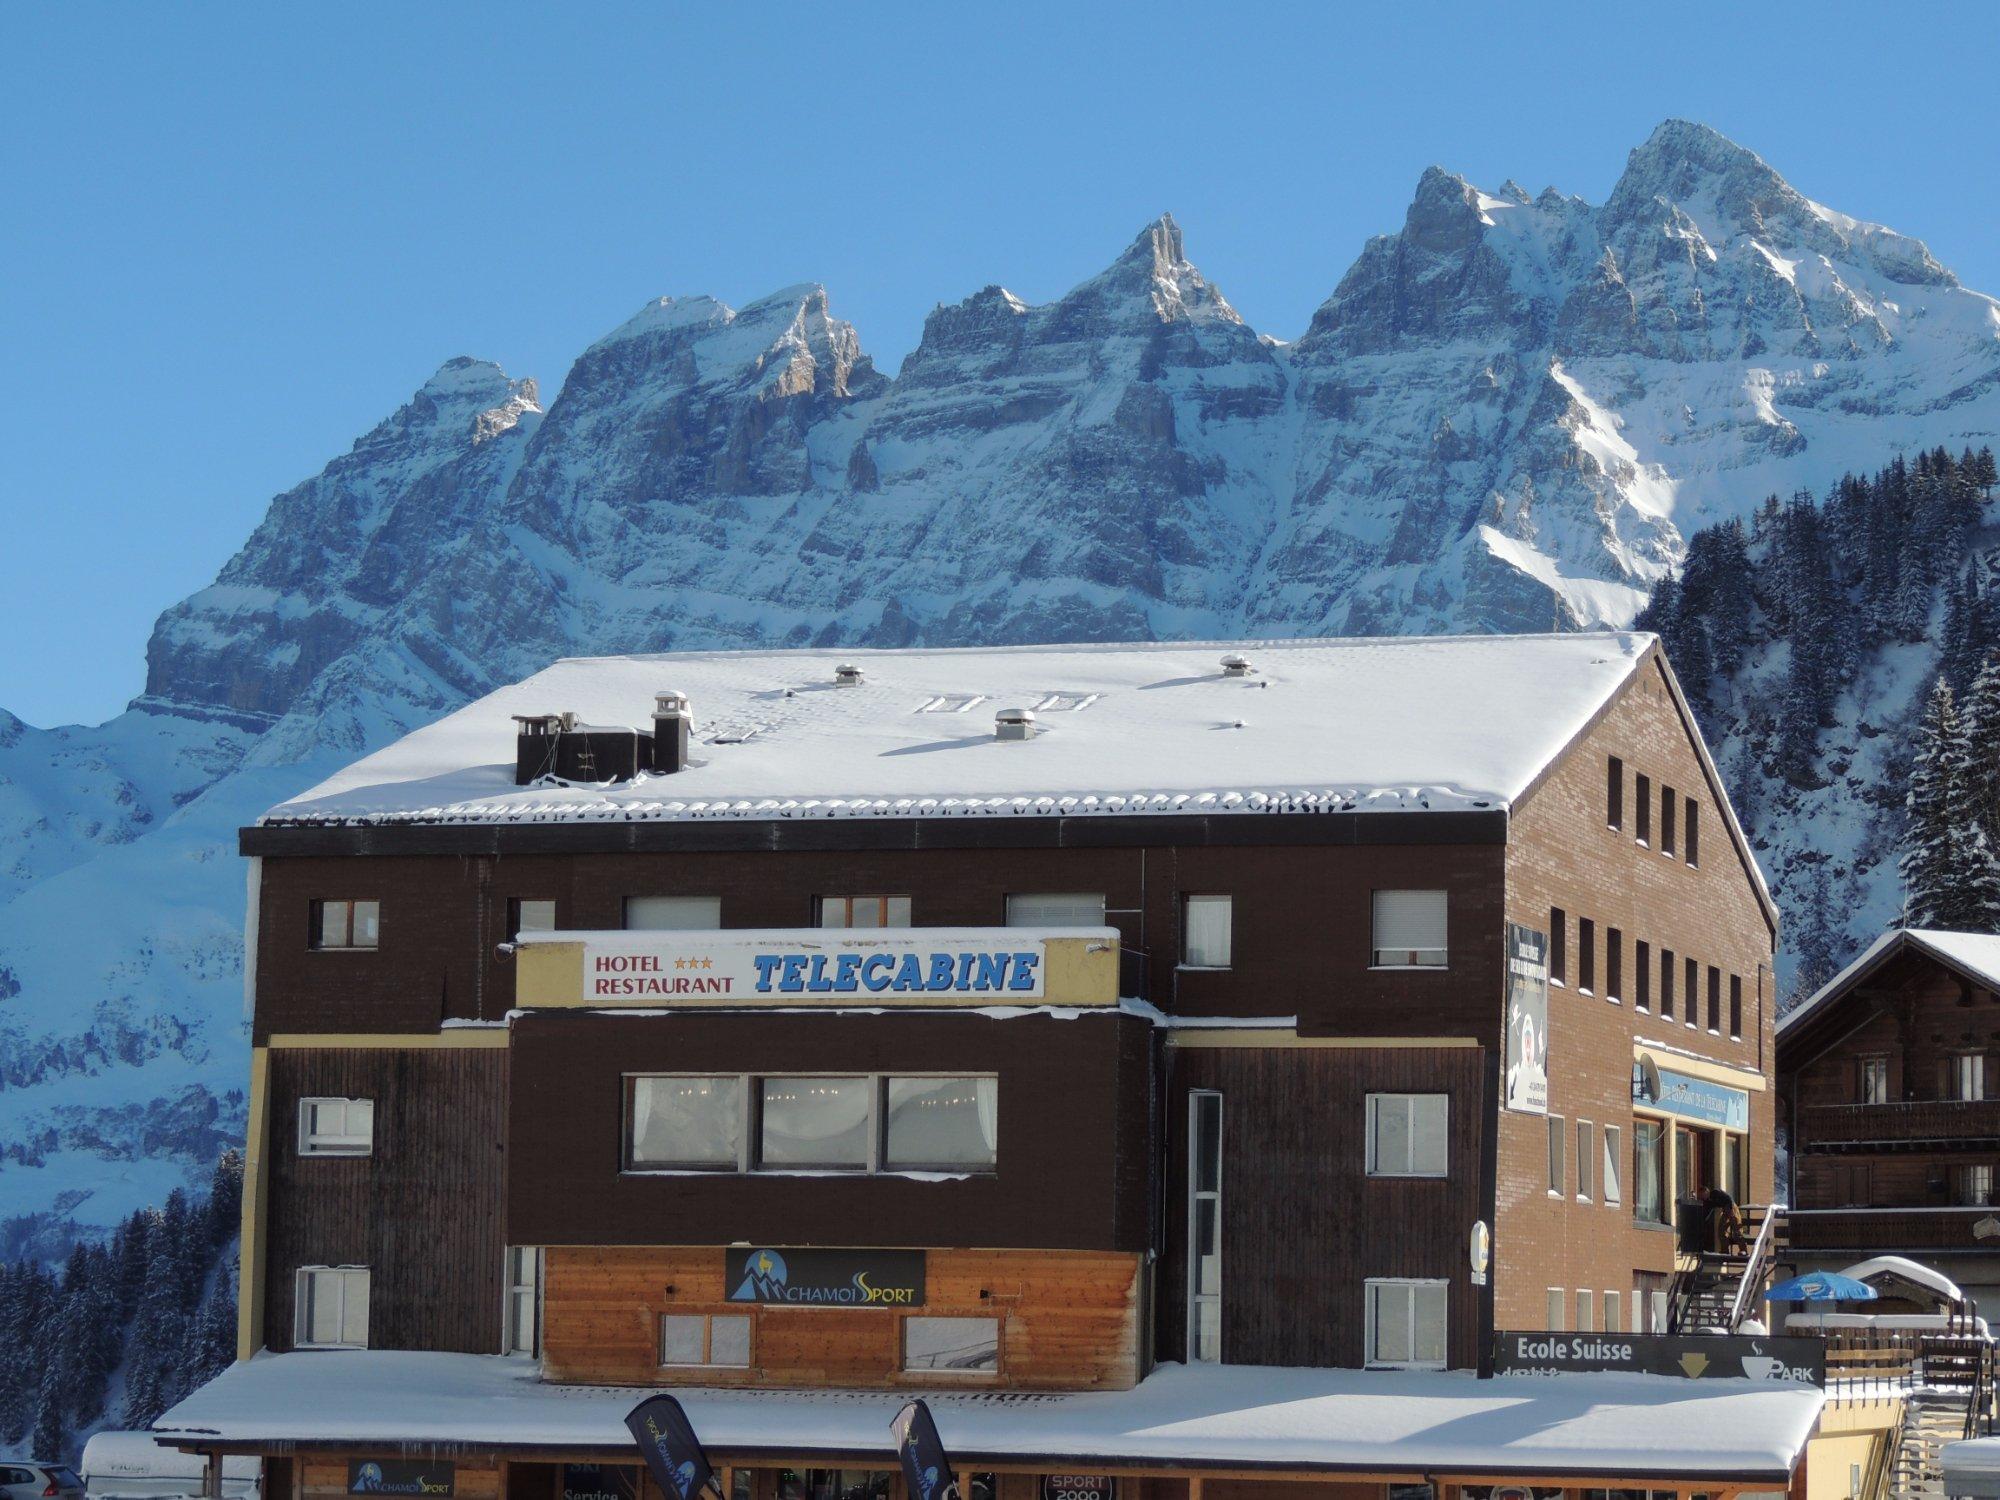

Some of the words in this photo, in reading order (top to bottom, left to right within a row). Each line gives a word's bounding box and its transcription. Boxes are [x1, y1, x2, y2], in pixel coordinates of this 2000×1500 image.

[596, 956, 663, 972] HOTEL
[753, 953, 1039, 992] TELECABINE
[596, 978, 734, 994] RESTAURANT
[1518, 1337, 1567, 1359] Ecole
[1572, 1338, 1632, 1360] Suisse
[1052, 1475, 1105, 1488] SPORT
[1056, 1490, 1100, 1500] 2000
